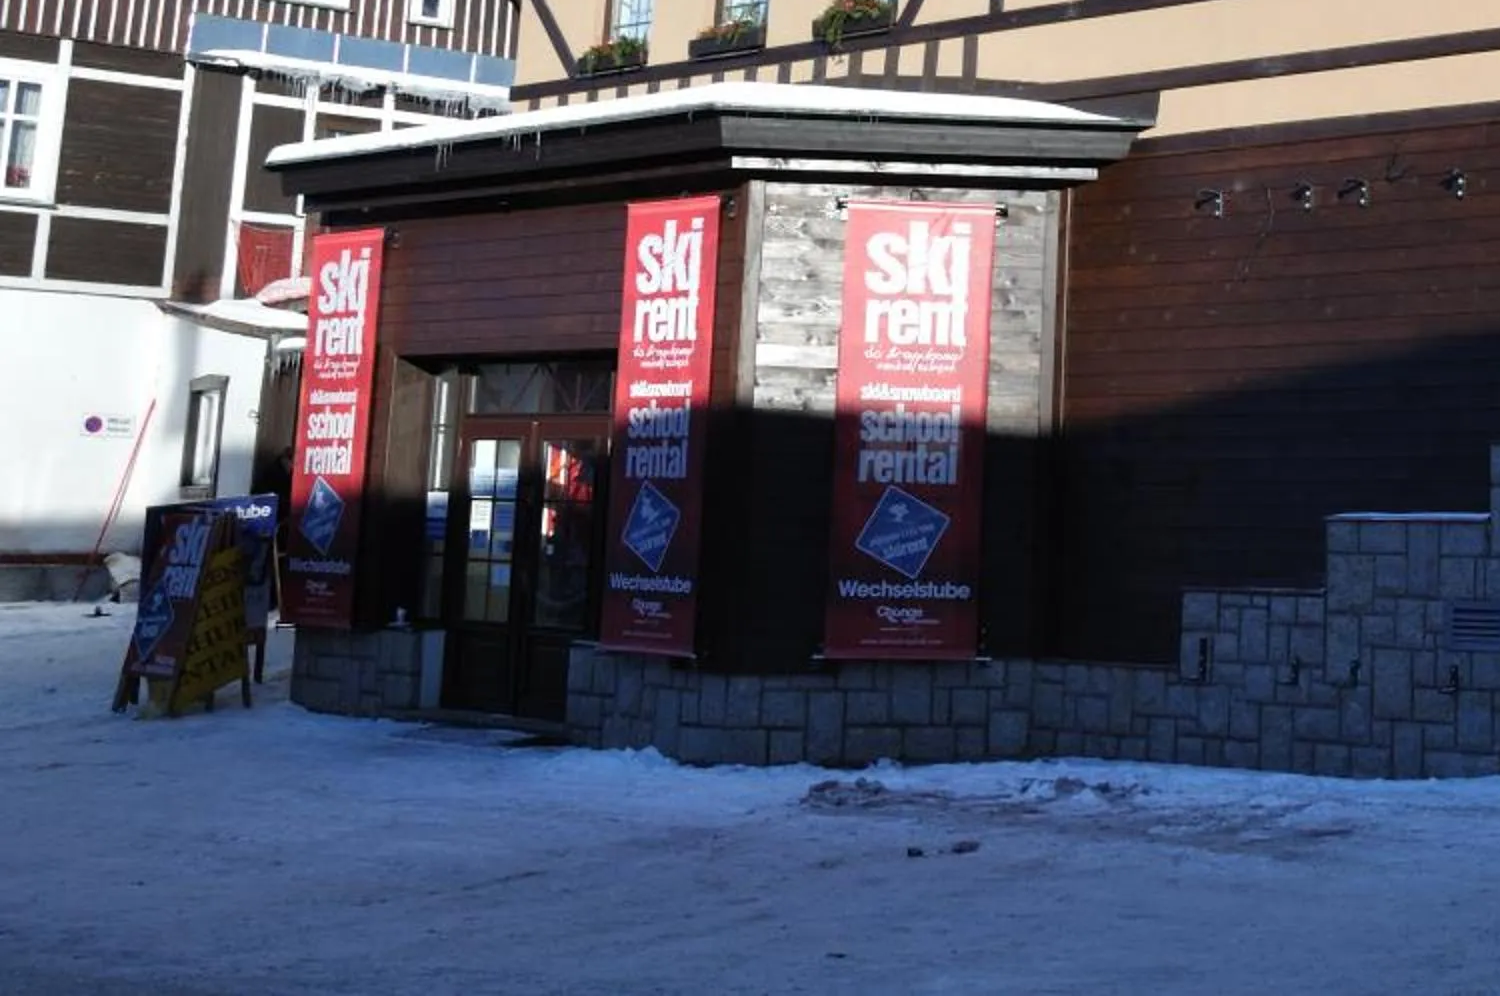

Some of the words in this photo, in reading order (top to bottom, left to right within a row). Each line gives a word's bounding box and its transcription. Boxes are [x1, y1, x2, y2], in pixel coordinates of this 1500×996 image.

[636, 217, 704, 297] ski
[864, 221, 972, 296] ski
[317, 247, 372, 314] ski
[314, 313, 364, 356] rent
[634, 295, 699, 342] rent
[864, 297, 968, 347] rent
[307, 405, 356, 440] school
[628, 399, 690, 438] school
[860, 403, 960, 443] school
[304, 441, 352, 475] rental
[626, 439, 687, 478] rental
[858, 444, 957, 485] rental
[234, 504, 272, 519] tube
[838, 580, 971, 599] Wechselstube
